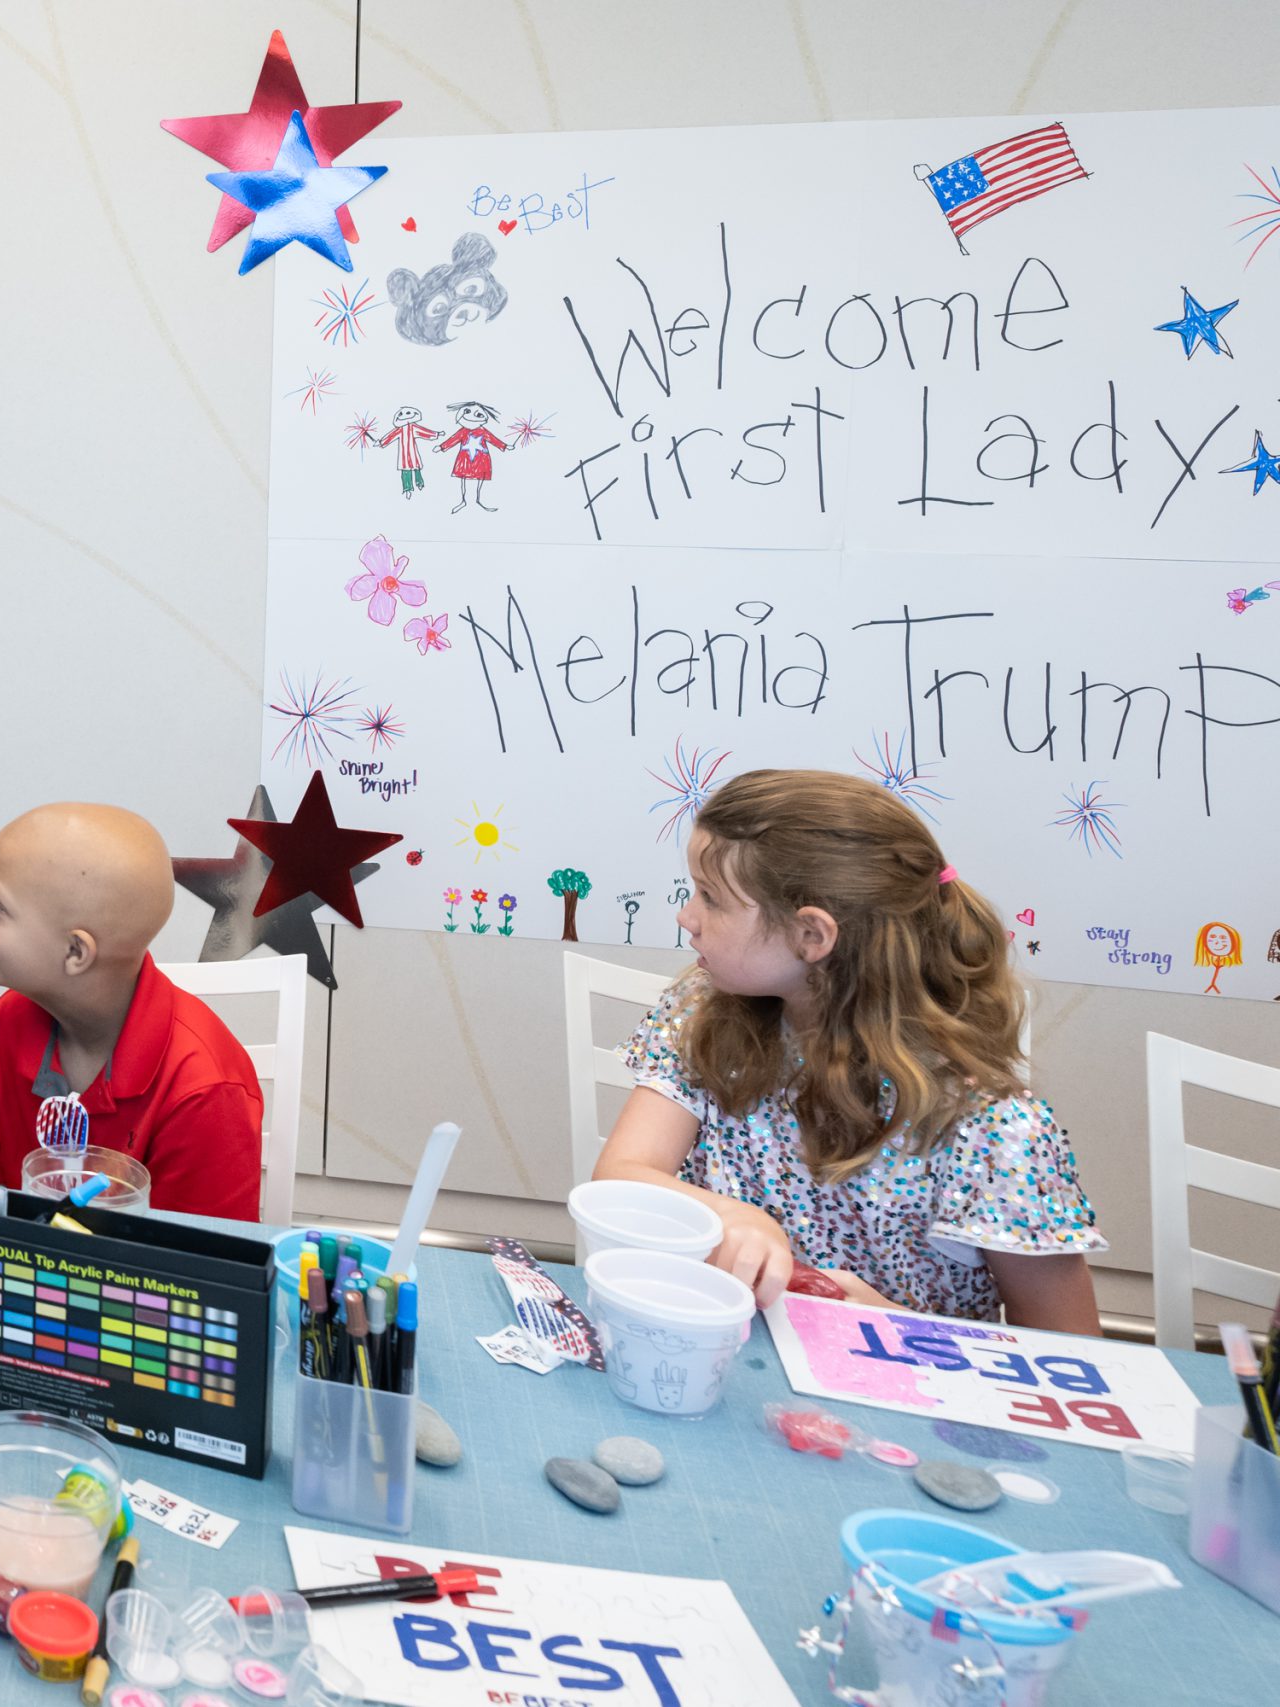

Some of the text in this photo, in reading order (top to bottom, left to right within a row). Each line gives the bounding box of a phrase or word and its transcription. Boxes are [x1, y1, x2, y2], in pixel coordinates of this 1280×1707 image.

[467, 185, 512, 217] Be
[563, 222, 1069, 419] Welcome
[564, 380, 1240, 540] First Lady
[459, 585, 1280, 817] Melania Trump
[358, 769, 418, 802] Bright!
[673, 877, 688, 885] ME
[35, 1253, 56, 1270] Tip
[58, 1258, 103, 1280] Acrylic
[105, 1269, 141, 1288] Paint
[143, 1277, 200, 1300] Markers
[848, 1321, 1111, 1396] BEST
[995, 1387, 1142, 1440] BE
[373, 1554, 514, 1614] BE
[393, 1612, 682, 1707] BEST
